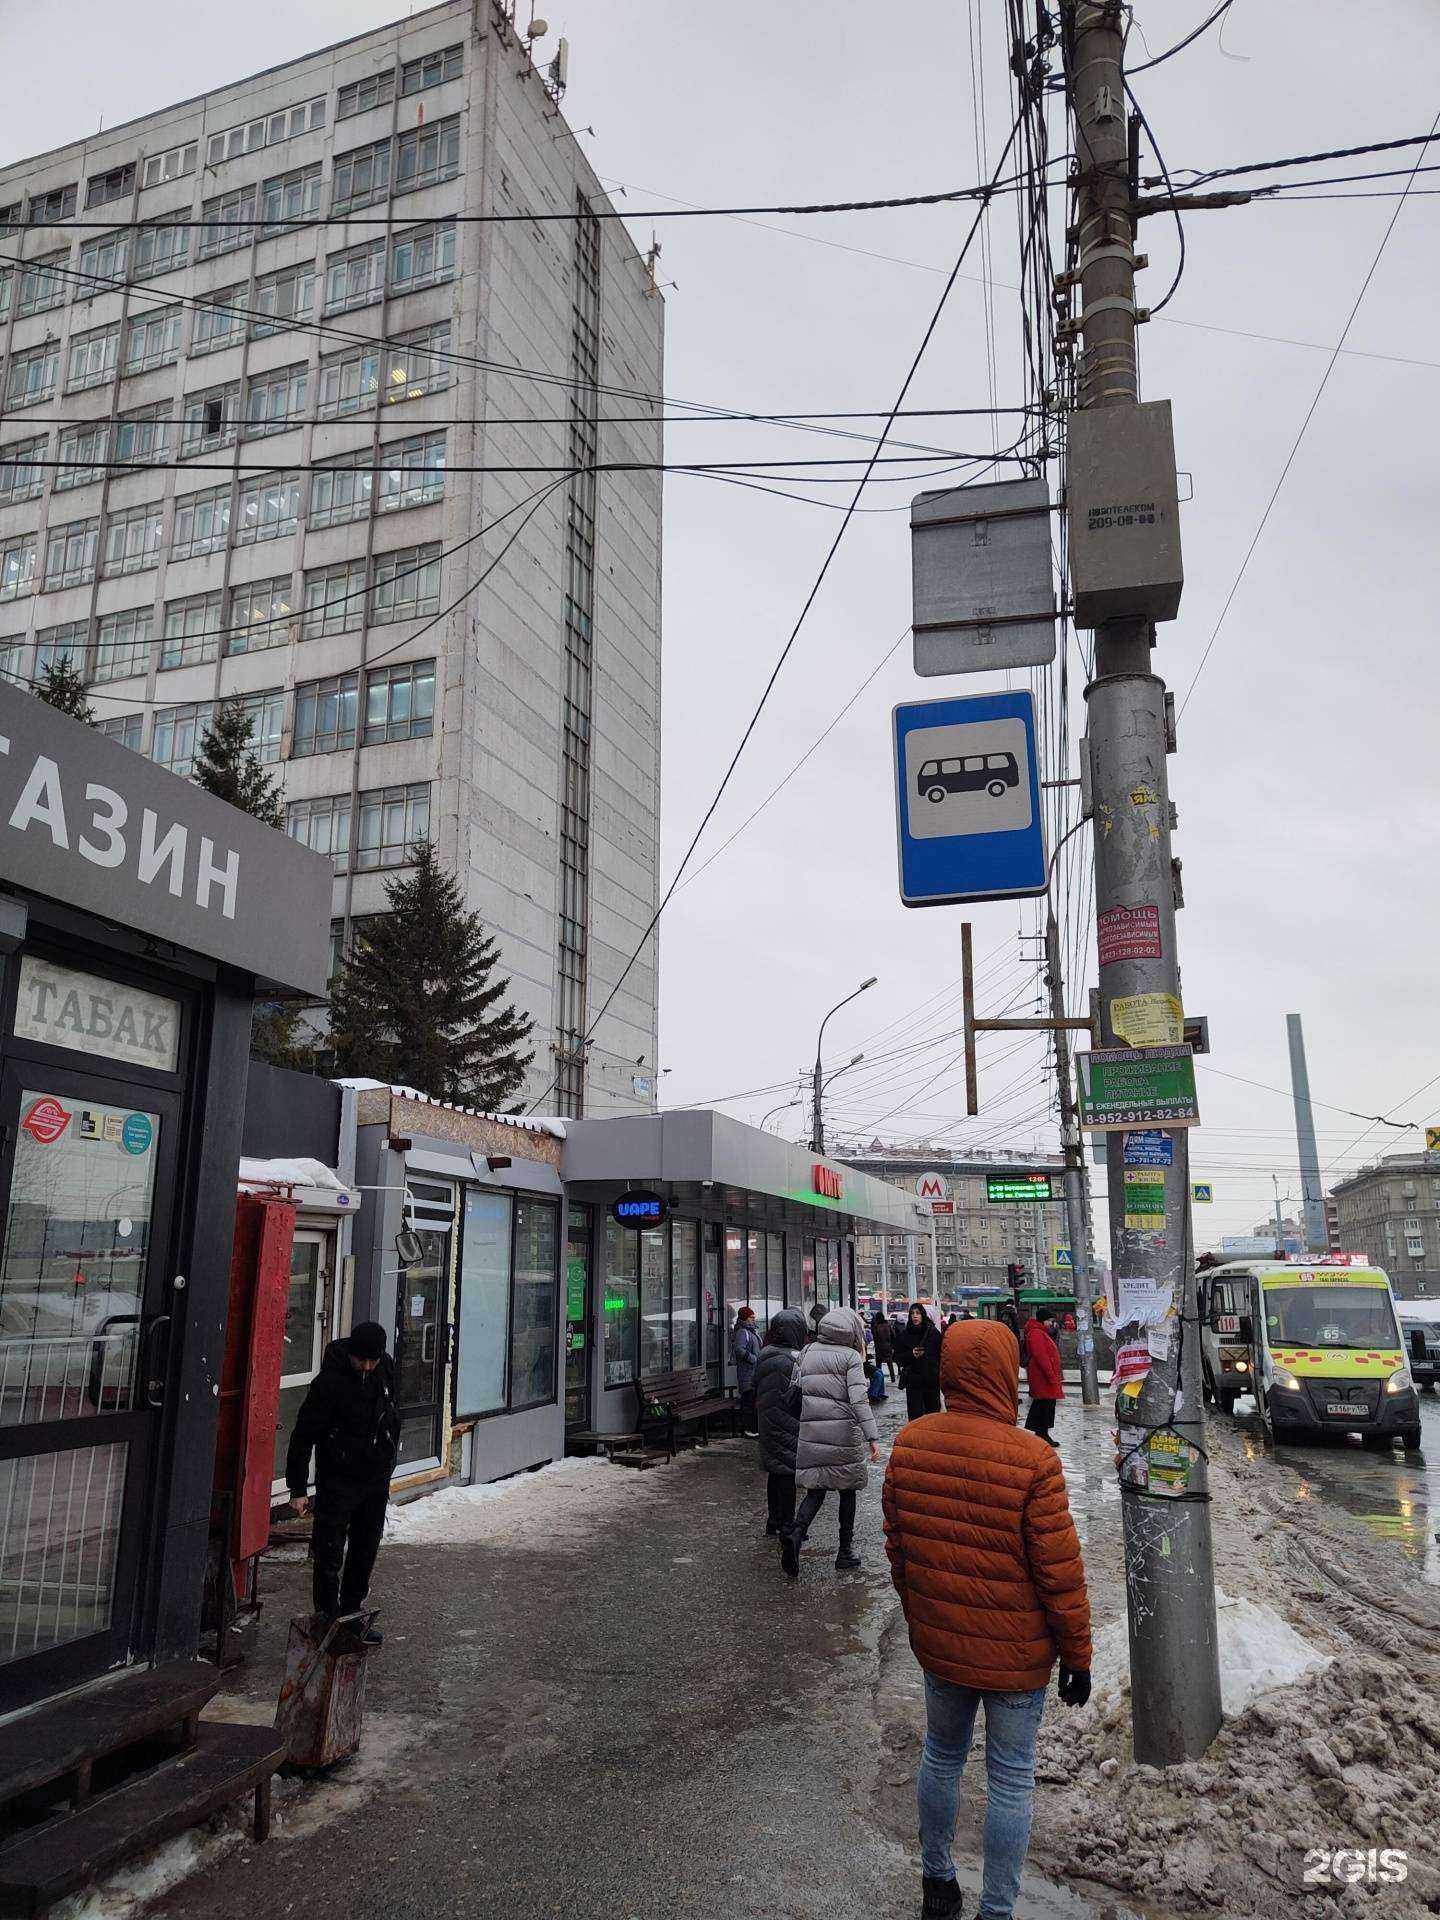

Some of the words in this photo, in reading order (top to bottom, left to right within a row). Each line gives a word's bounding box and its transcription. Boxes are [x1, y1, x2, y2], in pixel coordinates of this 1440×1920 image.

[0, 736, 240, 920] АЗИН
[28, 976, 169, 1054] ТАБАК
[1103, 1062, 1182, 1077] ПРОЖИВАНИЕ
[1103, 1076, 1149, 1088] РАБОТА
[1104, 1087, 1158, 1100] ПИТАНИЕ
[1096, 1099, 1154, 1111] ЕЖЕНЕДЕЛЬНЫЕ
[1156, 1096, 1194, 1106] ВЫПЛАТЫ
[1086, 1107, 1194, 1125] 8-952-912-82-84
